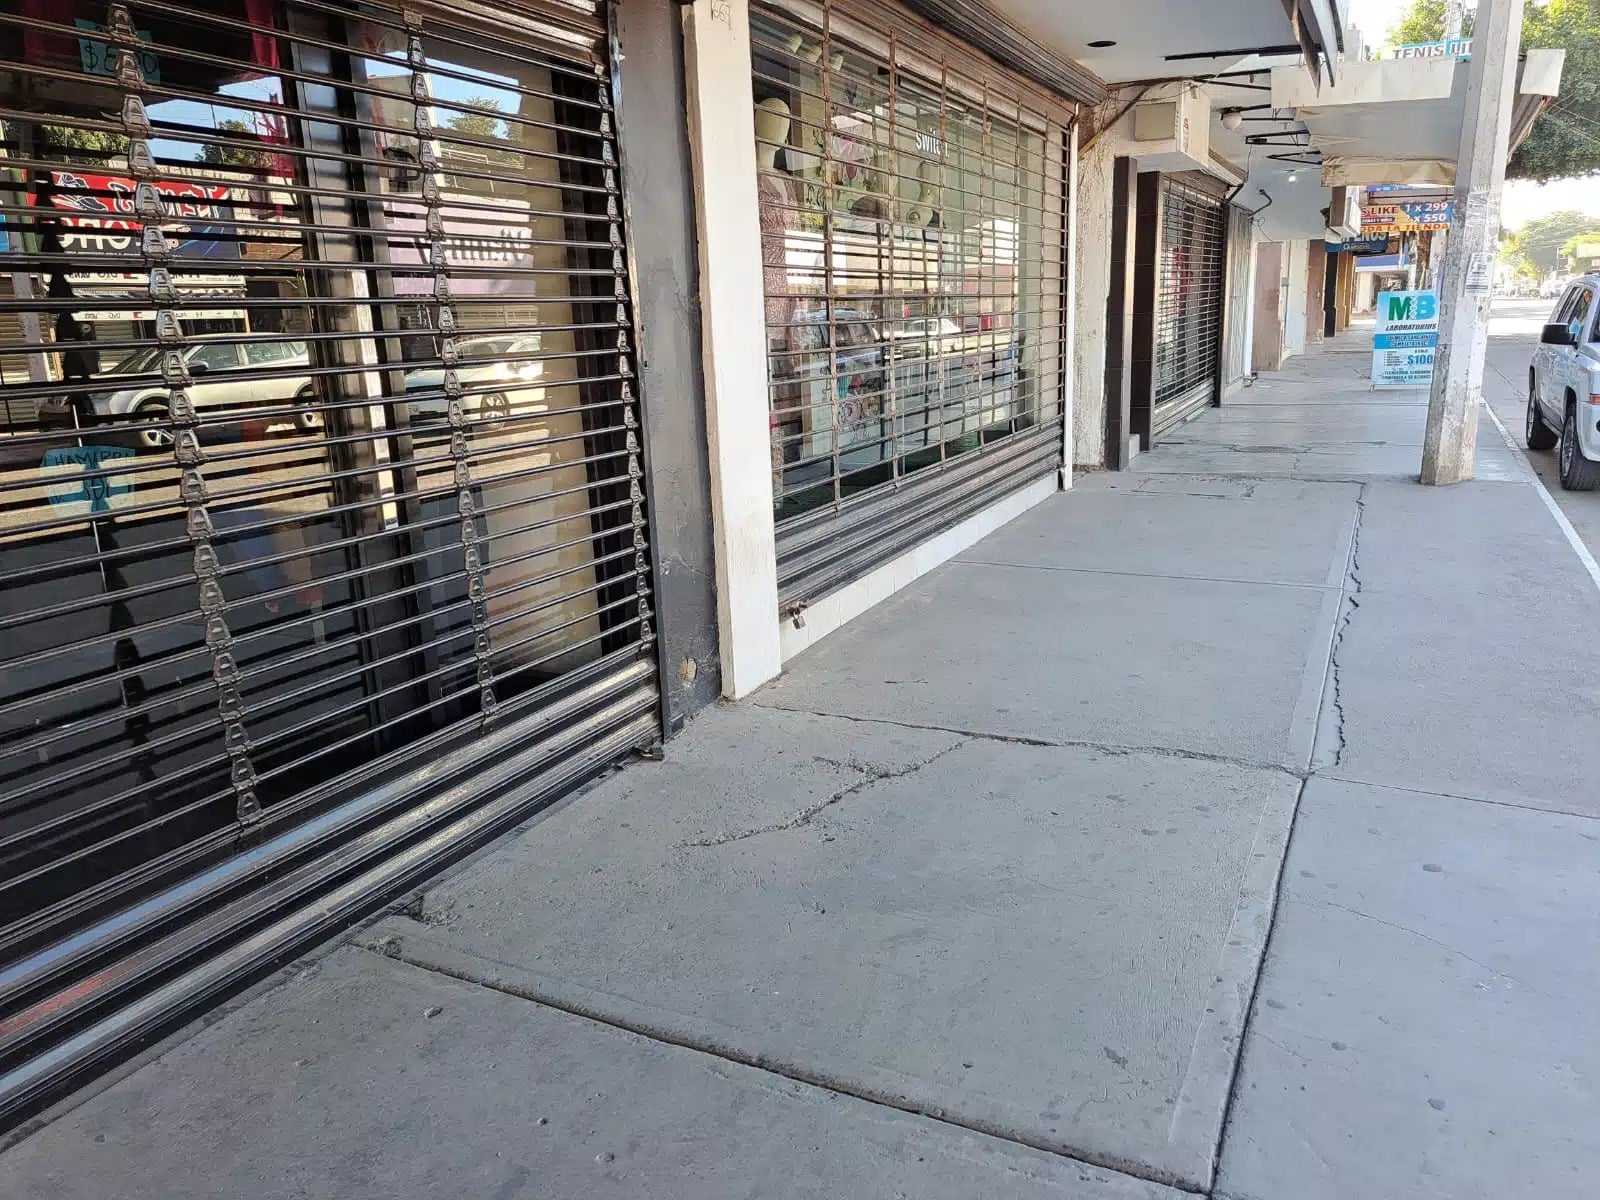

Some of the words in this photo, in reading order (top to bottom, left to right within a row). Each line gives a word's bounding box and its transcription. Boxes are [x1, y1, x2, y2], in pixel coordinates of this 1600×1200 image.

[1392, 44, 1444, 59] TENIS
[1371, 206, 1399, 215] LIKE
[1425, 202, 1448, 211] 299
[1424, 214, 1446, 222] 550
[1387, 224, 1400, 232] LA
[1404, 223, 1449, 231] TIENDA
[1408, 354, 1433, 364] $100
